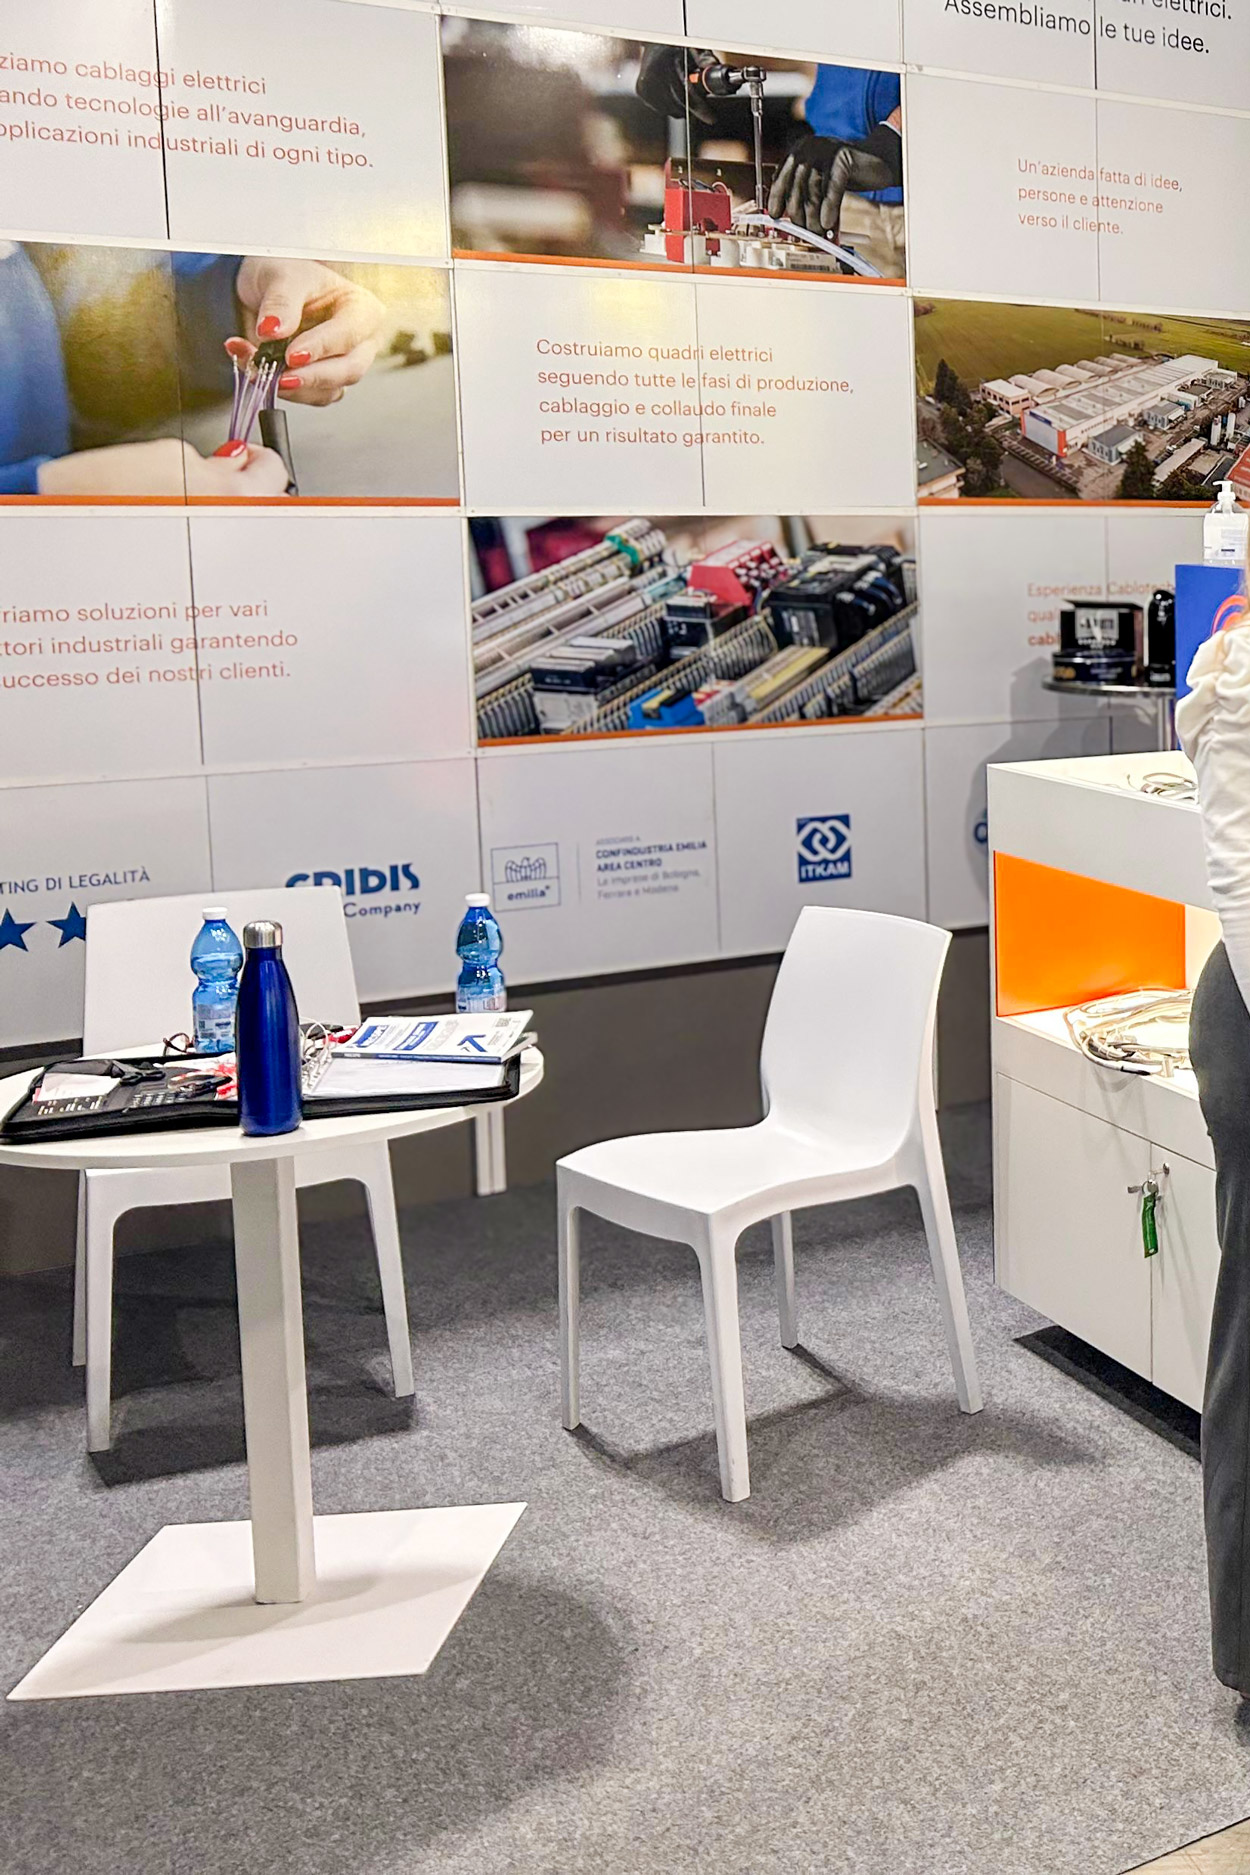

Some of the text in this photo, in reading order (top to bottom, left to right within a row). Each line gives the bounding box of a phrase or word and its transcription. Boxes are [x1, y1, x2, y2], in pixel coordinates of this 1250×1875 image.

[945, 0, 1210, 53] Assembliamo le tue idee.
[75, 61, 175, 88] cablaggi
[183, 70, 266, 94] elettrici
[65, 93, 189, 121] tecnologie
[128, 130, 238, 156] industriali
[246, 140, 265, 158] di
[273, 146, 320, 165] ogni
[327, 148, 374, 168] tipo.
[1018, 158, 1183, 193] Un'azienda fatta di idee,
[1018, 186, 1164, 214] persone e attenzione
[1018, 213, 1124, 235] verso il cliente.
[536, 338, 773, 363] Costruiamo quadri elettrici
[537, 370, 854, 394] seguendo tutte le fasi di produzione,
[539, 397, 777, 418] cablaggio e collaudo finale
[541, 427, 765, 447] per un risultato garantito.
[0, 600, 268, 623] riamo soluzioni per vari
[51, 634, 163, 655] industriali
[170, 630, 298, 653] garantendo
[0, 661, 291, 689] uccesso dei nostri clienti.
[624, 858, 662, 870] CENTRO
[800, 861, 849, 879] ITKAM
[45, 877, 62, 891] DI
[69, 866, 151, 889] LEGALITÀ
[343, 902, 421, 918] Company
